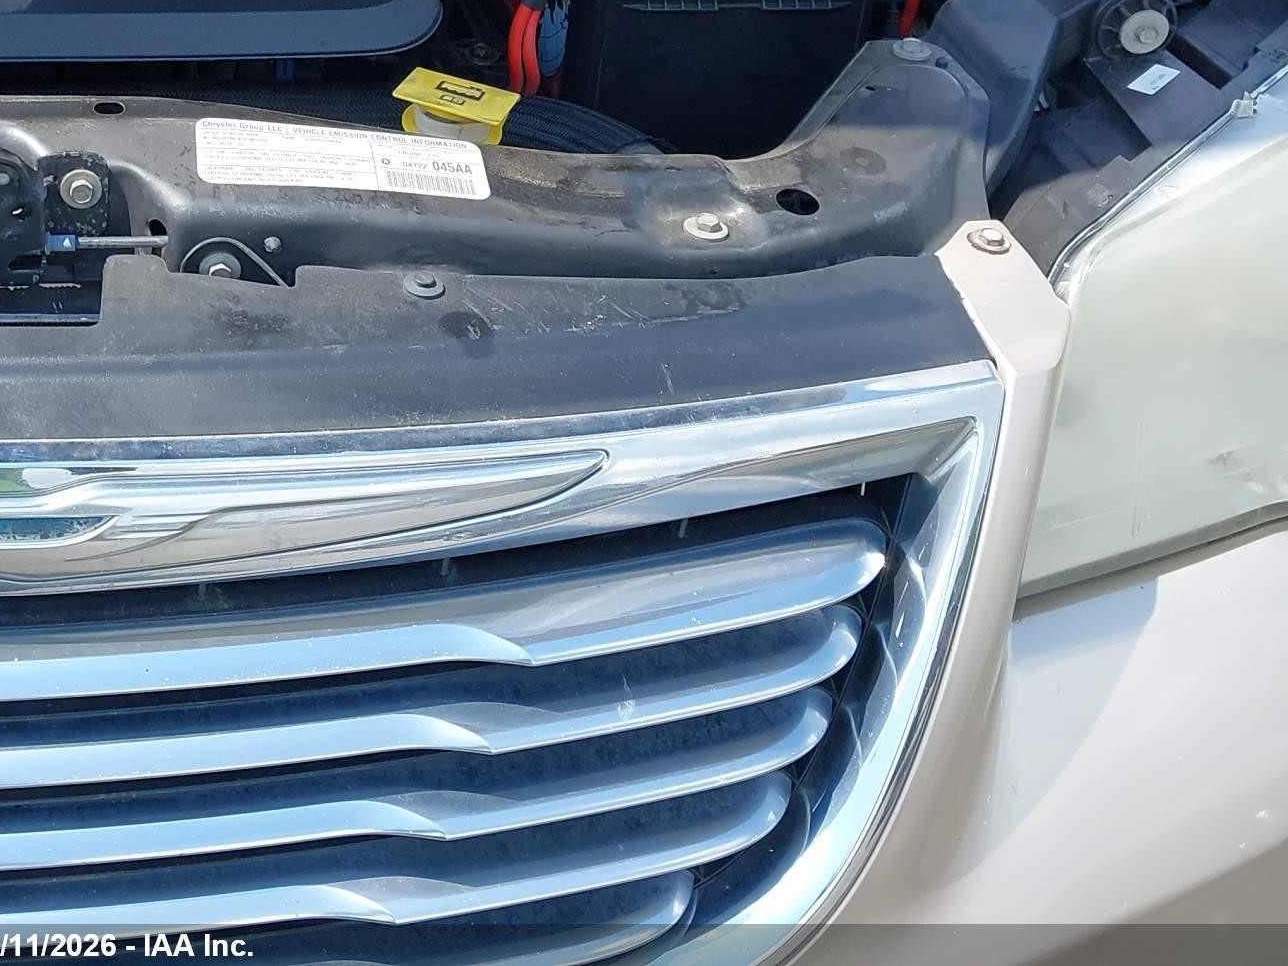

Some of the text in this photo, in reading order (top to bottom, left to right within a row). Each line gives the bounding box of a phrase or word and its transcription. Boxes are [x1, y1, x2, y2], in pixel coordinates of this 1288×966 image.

[202, 120, 237, 129] Chrysler
[239, 122, 264, 131] Group
[293, 127, 324, 136] VEHICLE
[411, 138, 468, 149] INFORMATION
[432, 161, 473, 174] 045AA
